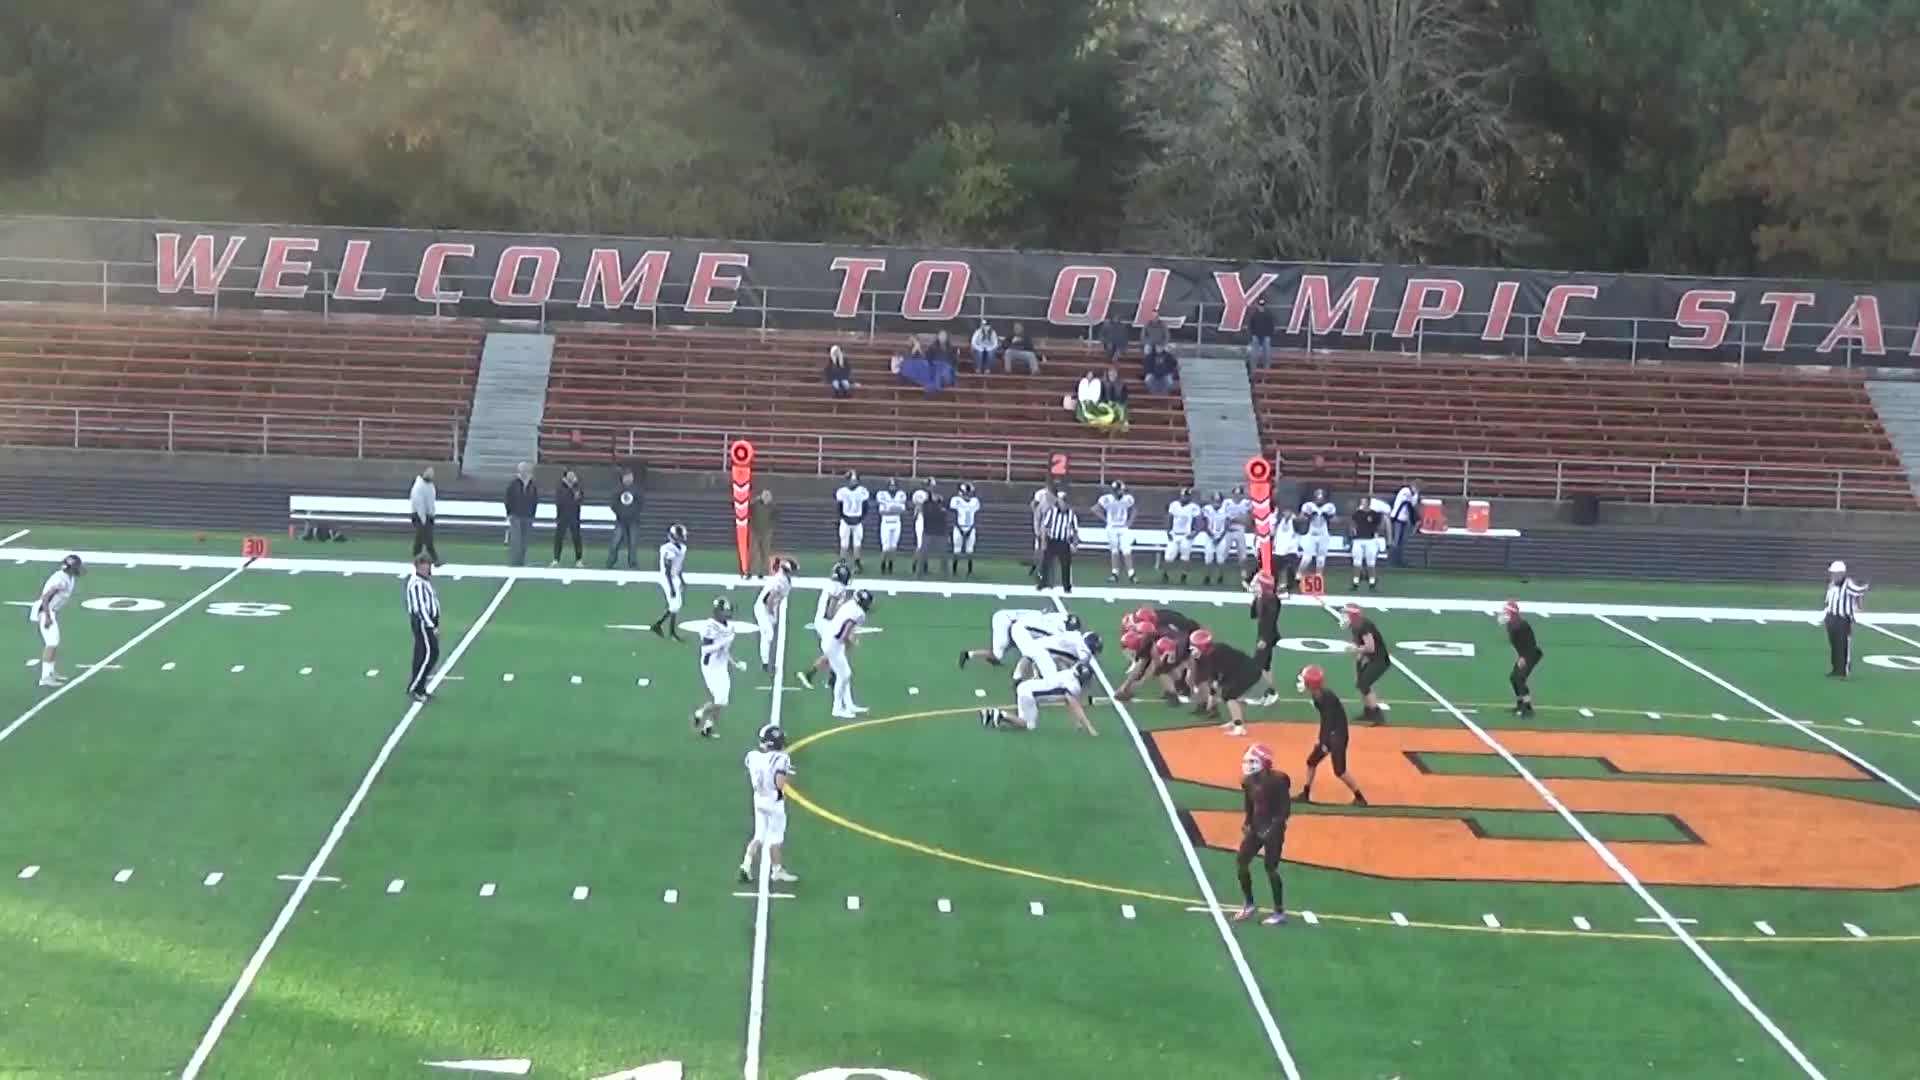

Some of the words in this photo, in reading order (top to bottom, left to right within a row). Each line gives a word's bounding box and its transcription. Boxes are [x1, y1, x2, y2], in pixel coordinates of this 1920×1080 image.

[155, 232, 749, 312] WELCOME
[830, 257, 971, 320] TO
[1047, 265, 1599, 344] OLYMPIC
[1668, 289, 1920, 355] STA
[1304, 575, 1322, 592] 50
